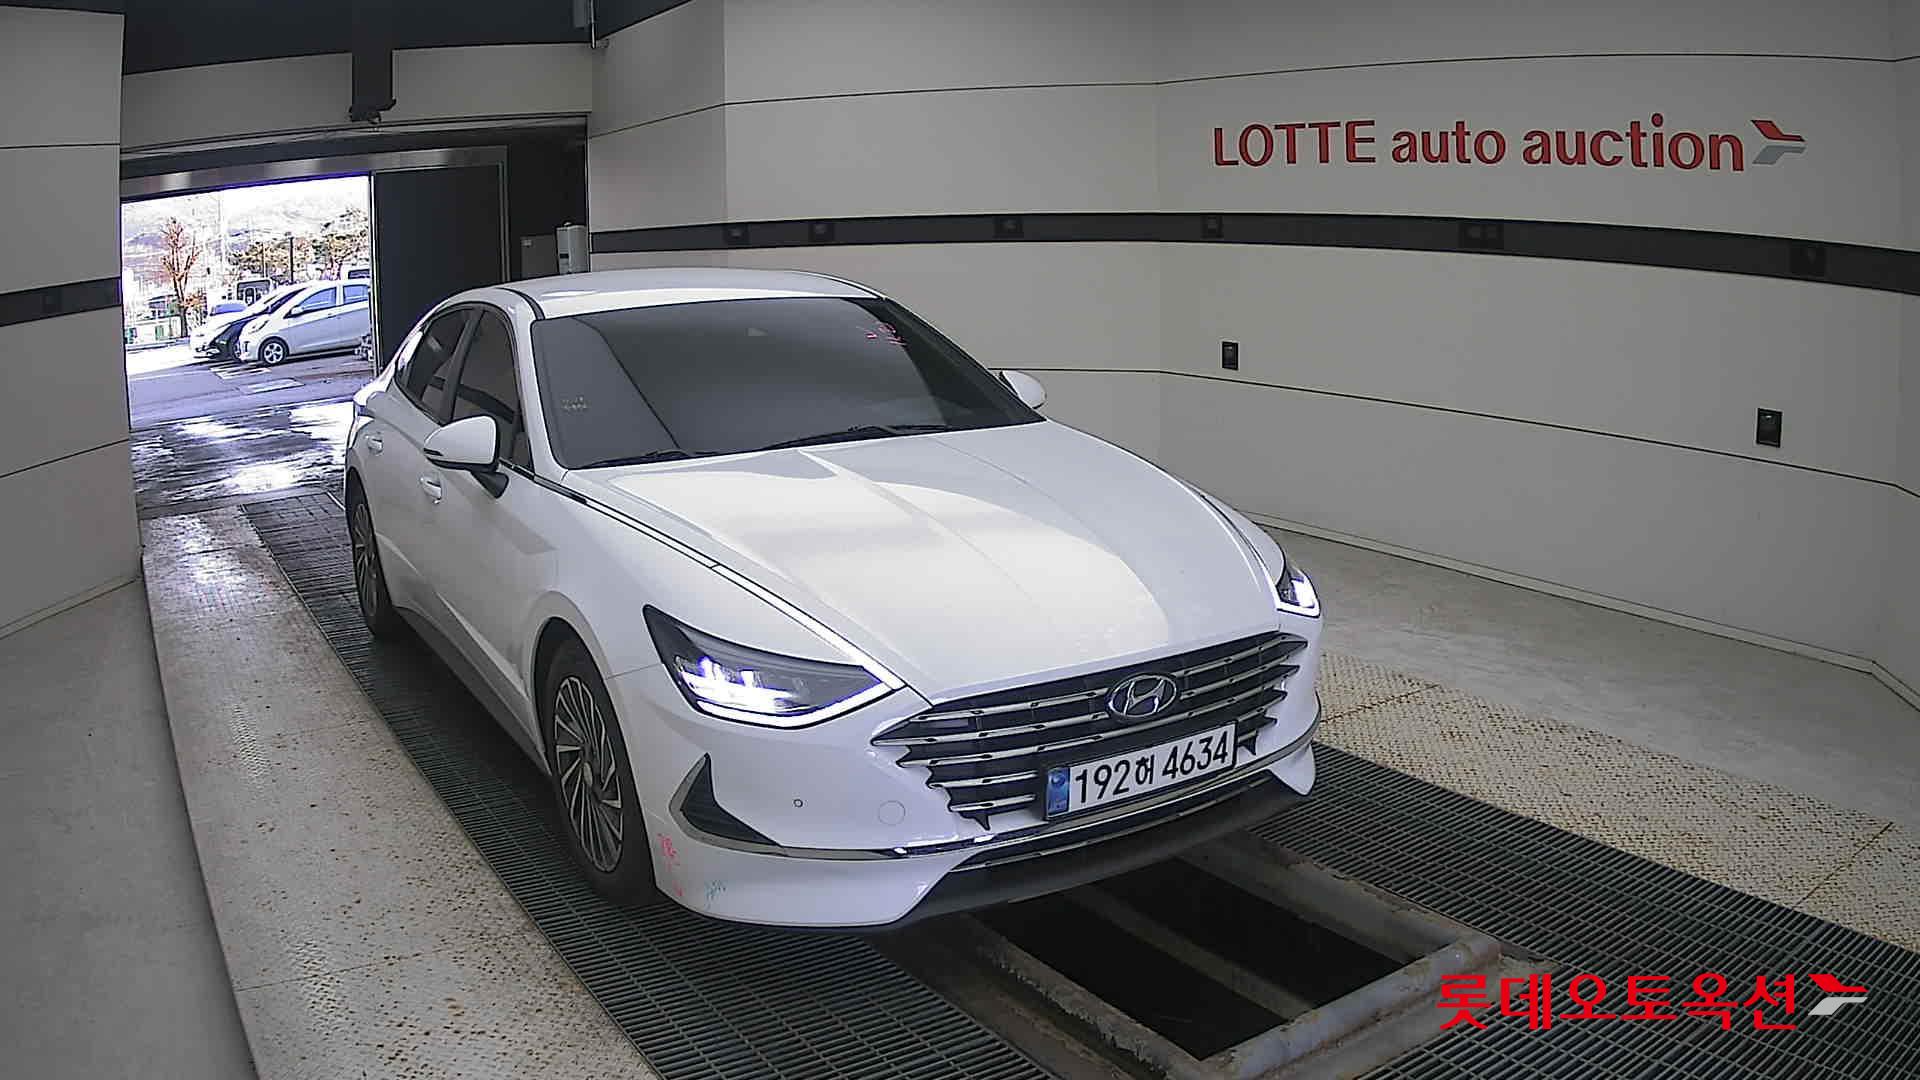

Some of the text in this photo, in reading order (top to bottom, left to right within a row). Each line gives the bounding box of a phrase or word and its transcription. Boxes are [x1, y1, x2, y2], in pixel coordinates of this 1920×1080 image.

[1213, 113, 1744, 172] LOTTE auto auction
[1075, 731, 1228, 803] 192허 4634
